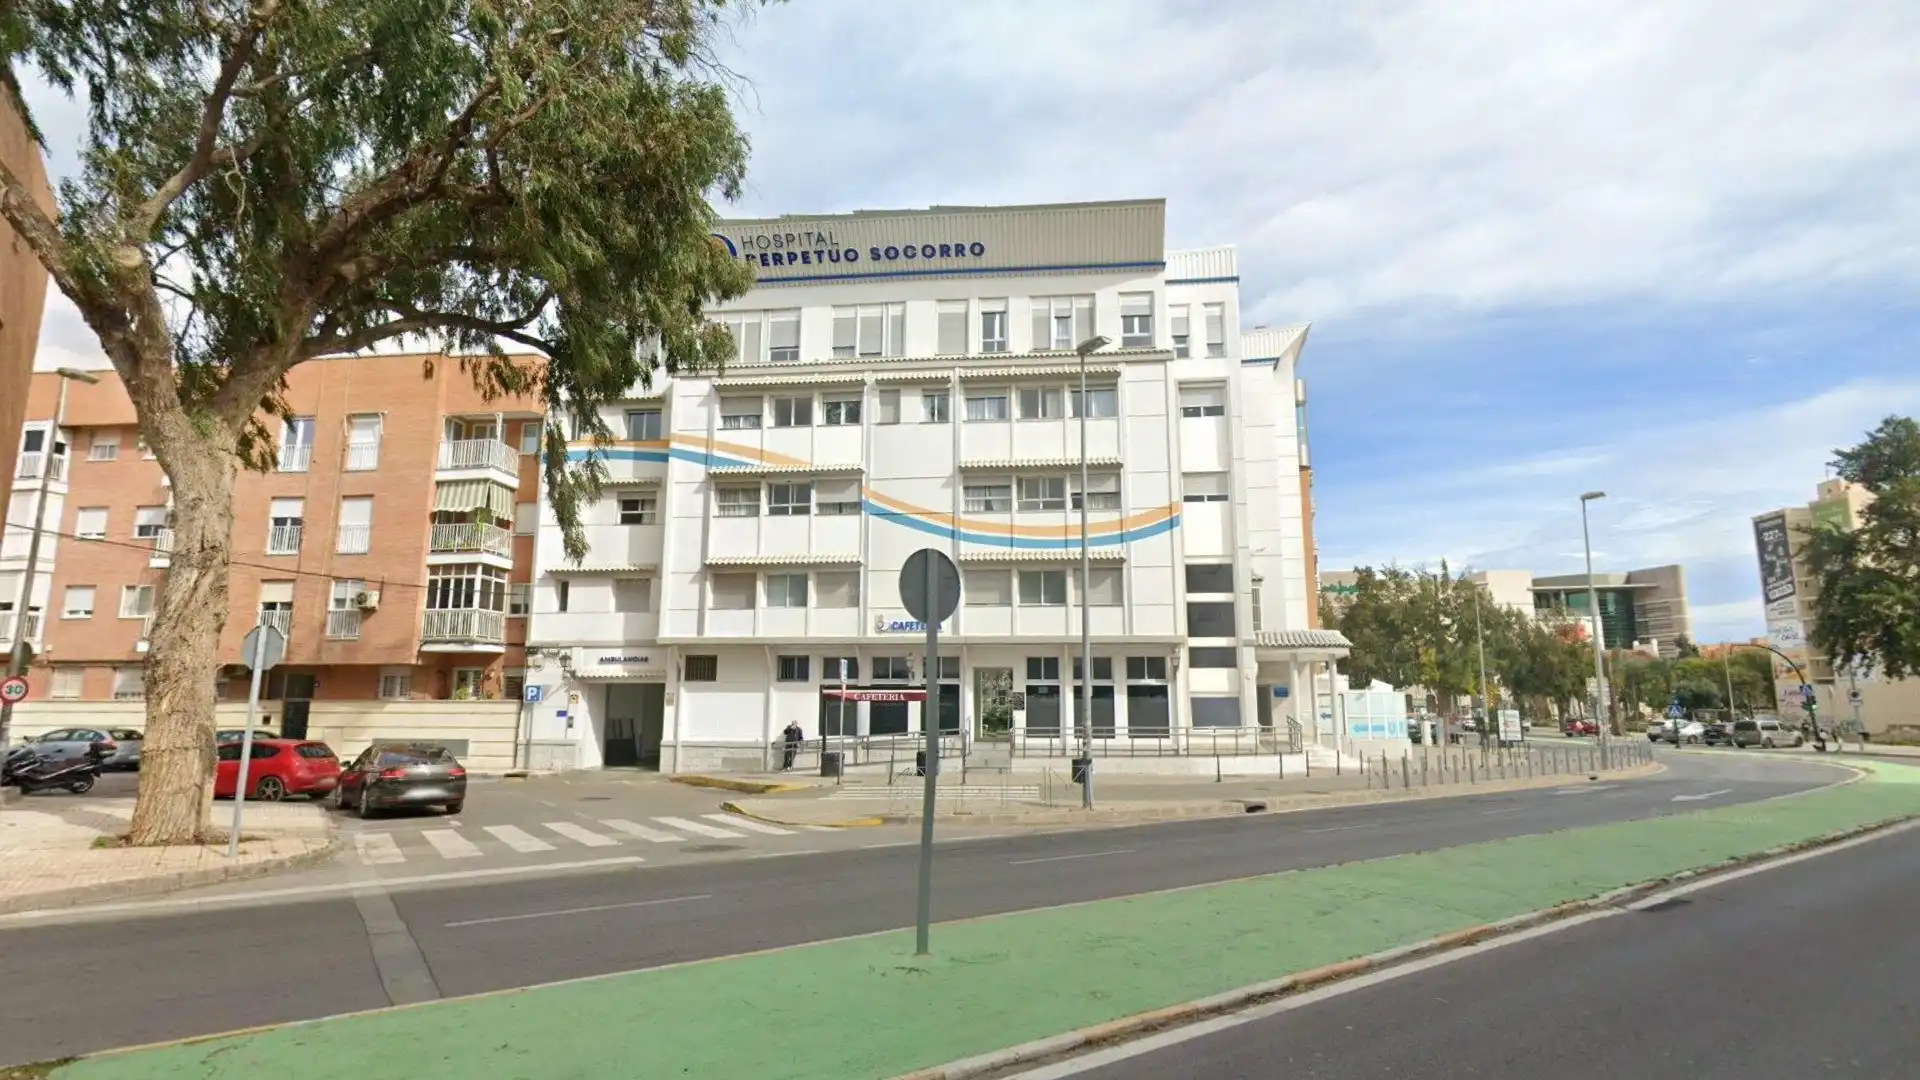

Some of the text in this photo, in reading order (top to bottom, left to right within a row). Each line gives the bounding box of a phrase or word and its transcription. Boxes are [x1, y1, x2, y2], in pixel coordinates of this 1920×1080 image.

[741, 231, 839, 250] HOSPITAL
[745, 241, 985, 267] PERPETUO SOCORRO
[5, 684, 24, 695] 30
[527, 687, 537, 700] P
[853, 693, 905, 701] CAFETERIA
